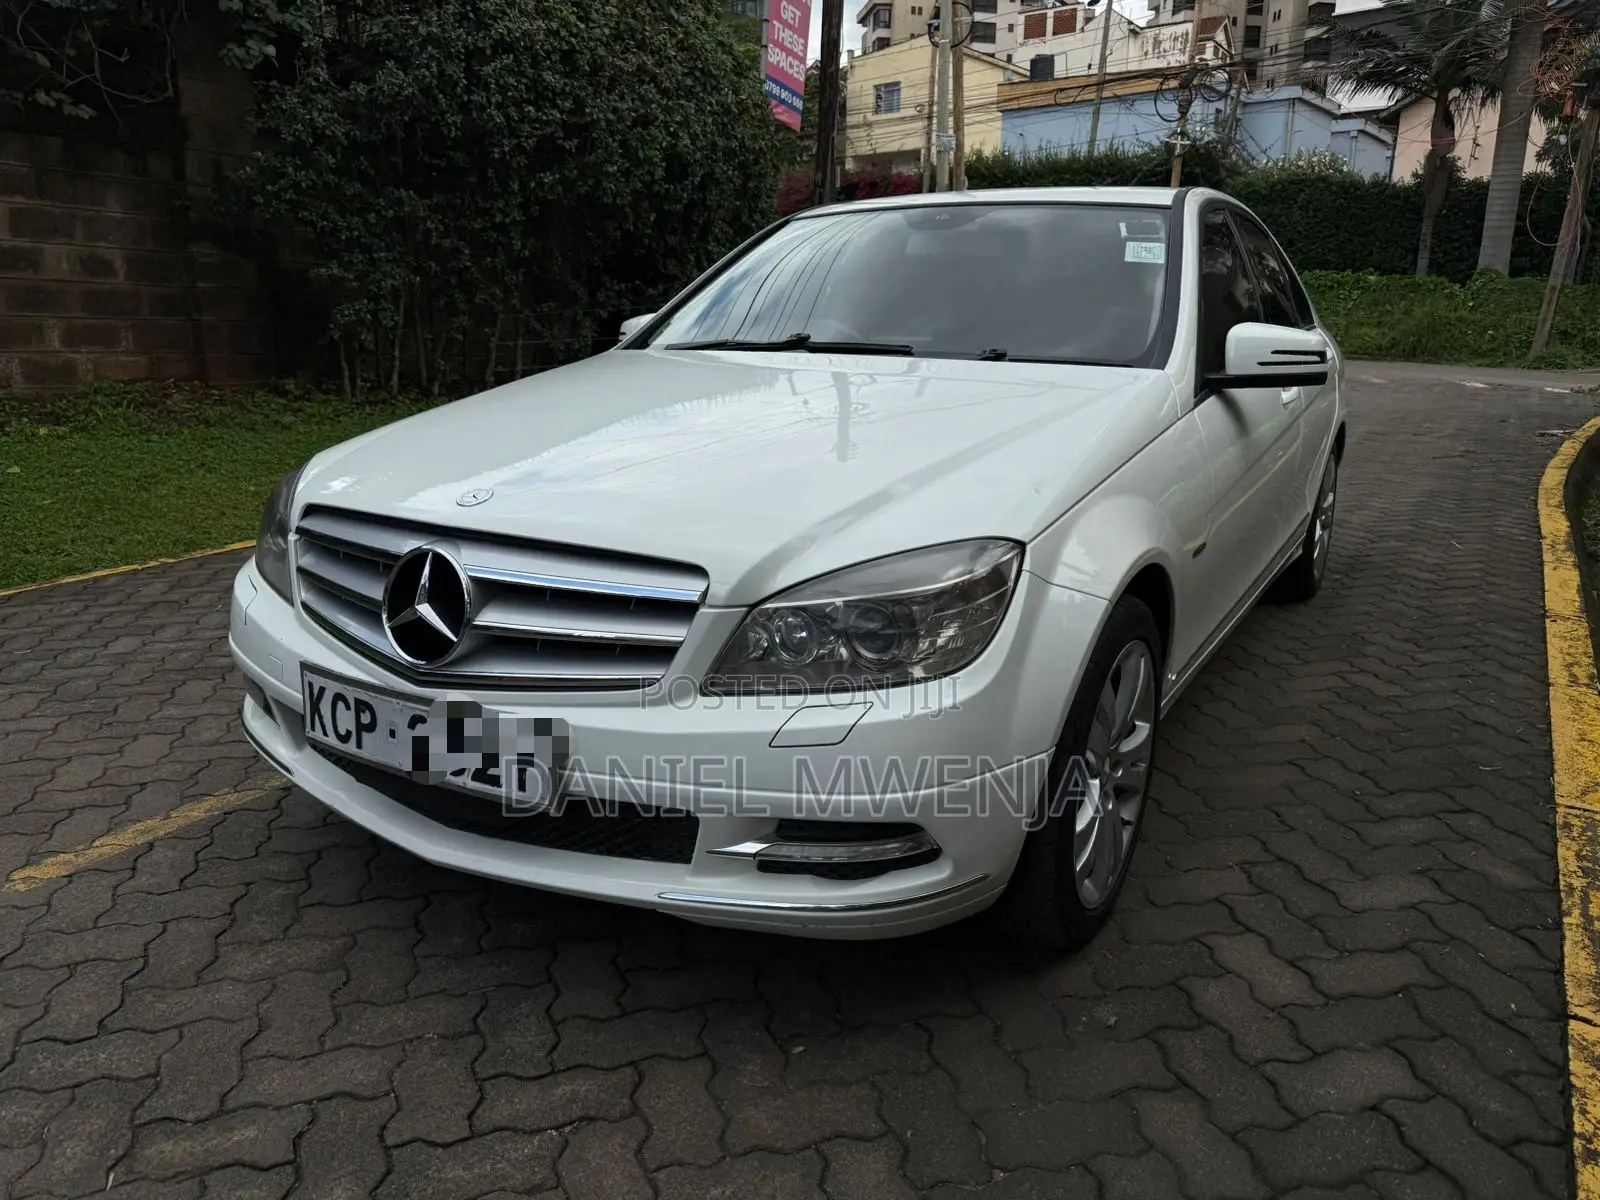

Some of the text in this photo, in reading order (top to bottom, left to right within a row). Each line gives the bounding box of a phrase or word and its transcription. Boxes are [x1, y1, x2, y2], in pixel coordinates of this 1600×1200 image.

[780, 1, 801, 28] GET
[773, 20, 804, 56] THESE
[767, 44, 805, 81] SPACES
[307, 681, 377, 750] KCP
